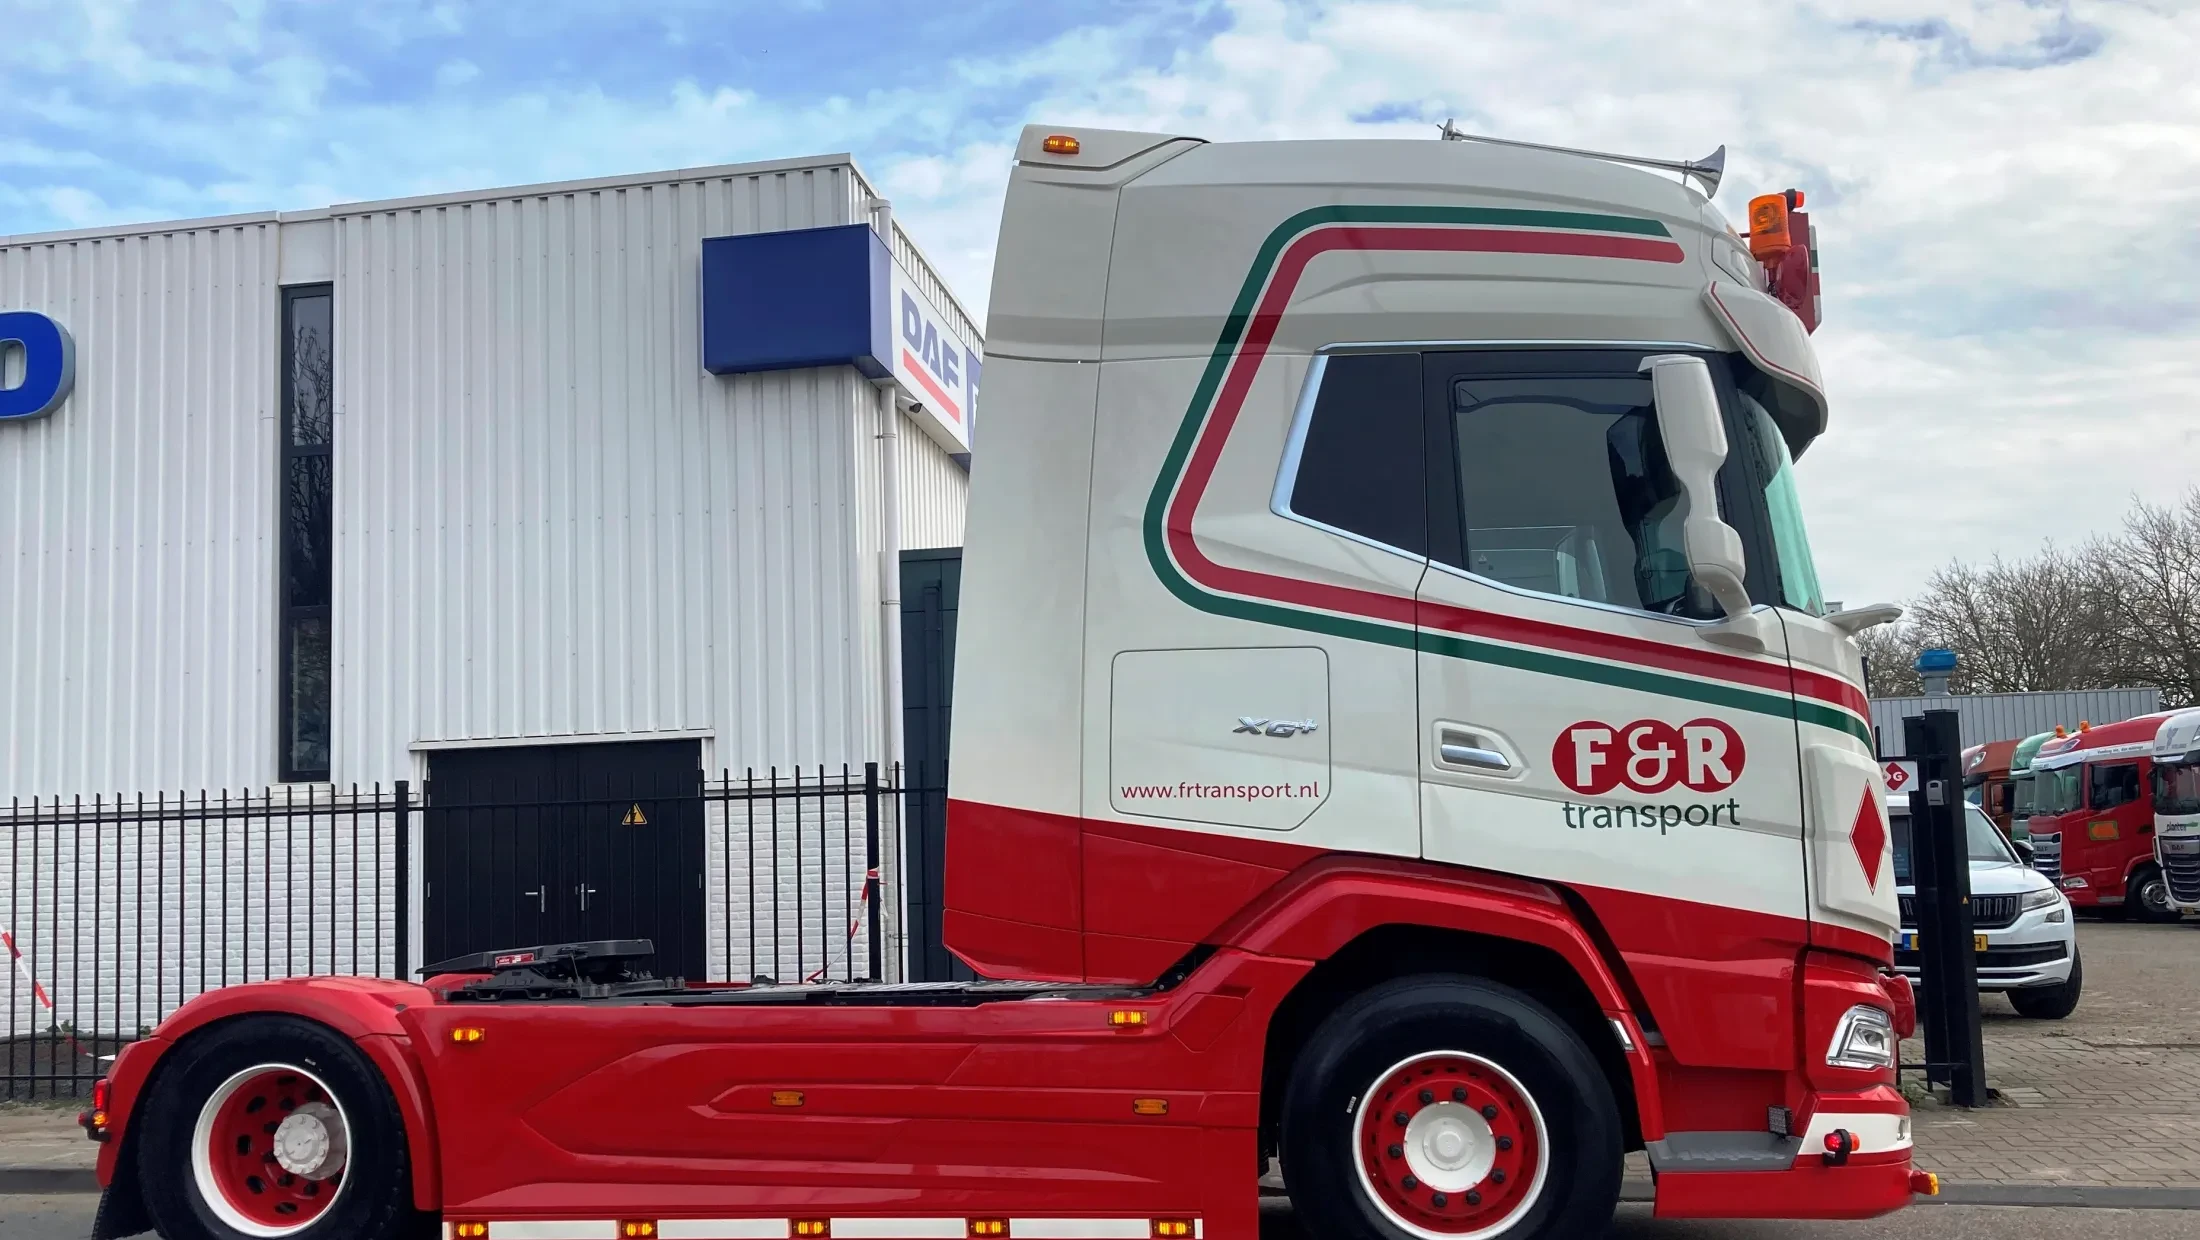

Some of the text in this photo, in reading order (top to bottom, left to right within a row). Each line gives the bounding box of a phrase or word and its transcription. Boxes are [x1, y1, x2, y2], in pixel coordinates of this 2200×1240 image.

[901, 288, 959, 390] DAF
[1233, 717, 1318, 738] XG+
[1571, 726, 1733, 786] F&R
[1892, 771, 1903, 782] G
[1121, 781, 1320, 802] www.frtransport.nl
[1562, 798, 1741, 836] transport
